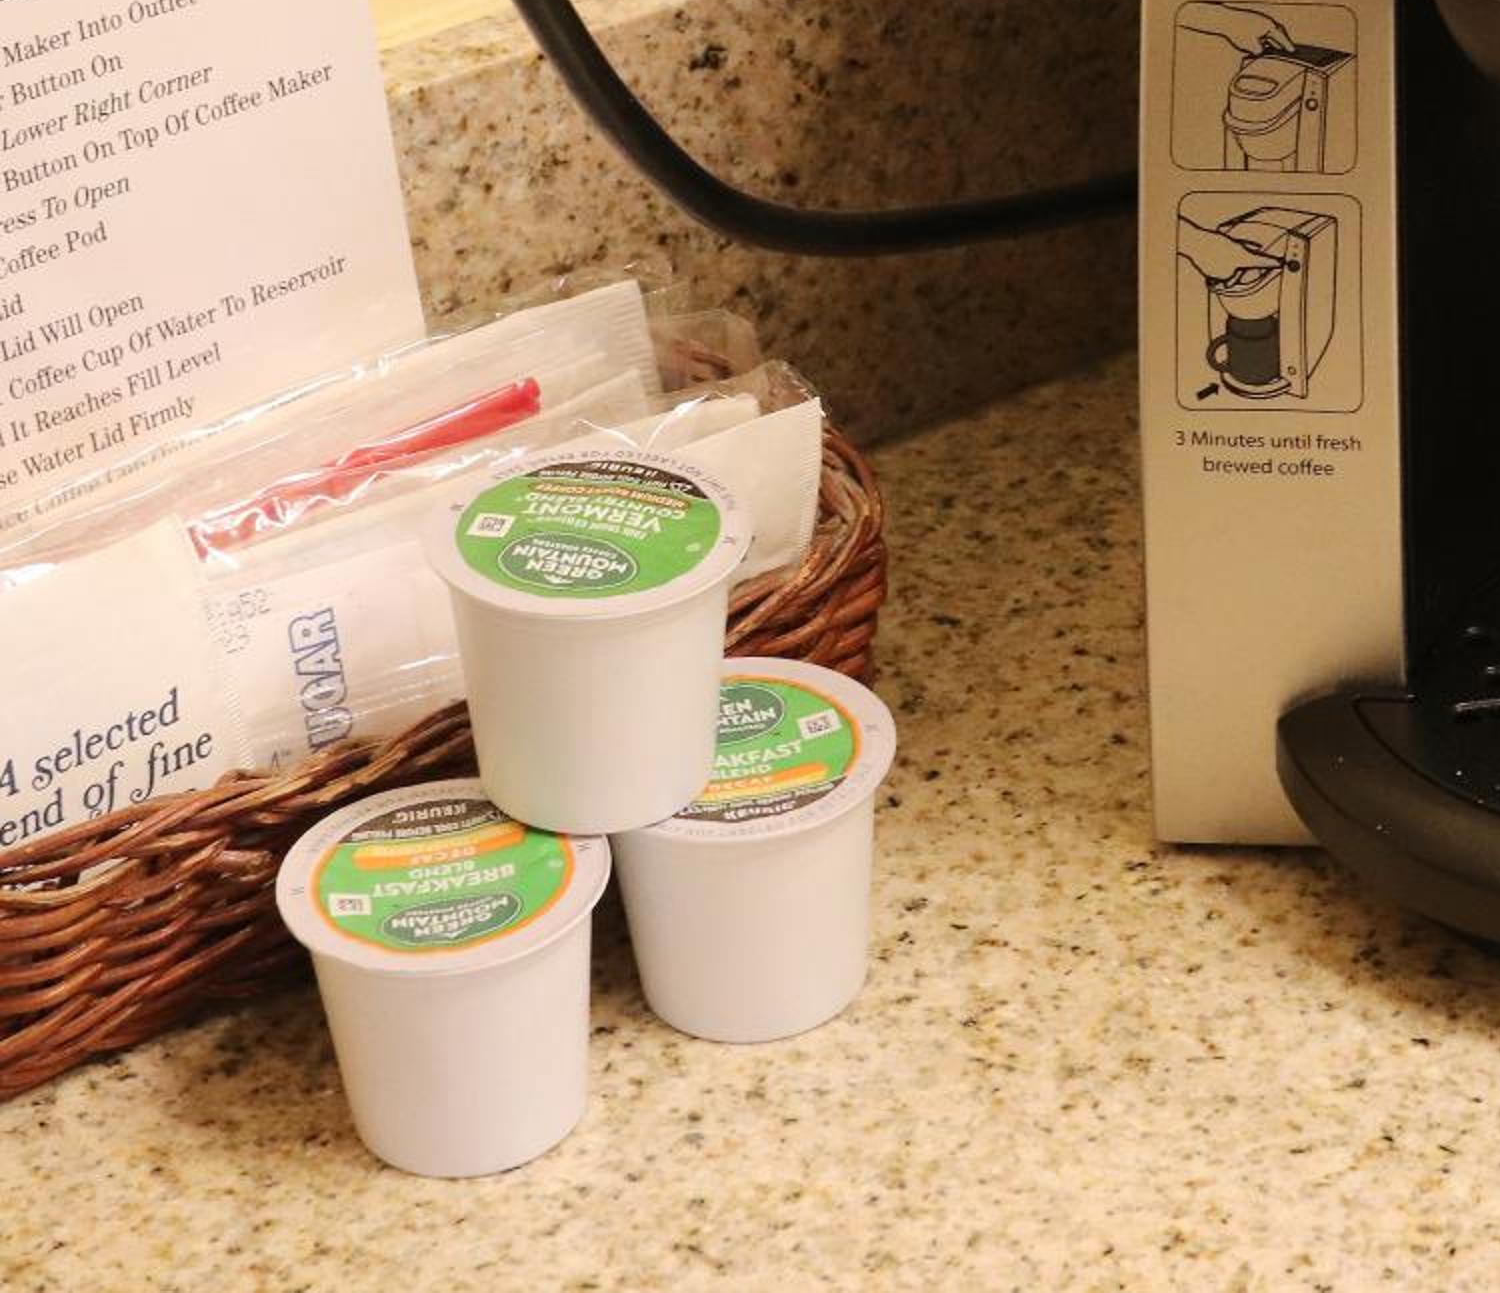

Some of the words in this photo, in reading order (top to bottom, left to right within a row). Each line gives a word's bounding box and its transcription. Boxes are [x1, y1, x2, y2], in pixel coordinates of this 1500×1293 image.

[2, 27, 72, 67] Maker
[77, 12, 123, 41] Into
[11, 67, 85, 106] Button
[91, 53, 123, 78] On
[1, 113, 69, 151] Lower
[74, 88, 132, 127] Right
[138, 64, 214, 104] Corner
[3, 153, 77, 192] Button
[83, 138, 116, 164] On
[118, 123, 159, 152] Top
[165, 108, 191, 135] Of
[195, 87, 262, 125] Coffee
[267, 62, 333, 102] Maker
[0, 208, 37, 235] ess
[41, 195, 67, 220] To
[74, 174, 131, 211] Open
[64, 221, 108, 255] Pod
[0, 330, 36, 363] Lid
[39, 316, 84, 349] Will
[88, 292, 144, 329] Open
[8, 362, 76, 401] Coffee
[82, 343, 124, 376] Cup
[128, 326, 154, 355] Of
[156, 308, 217, 342] Water
[220, 293, 246, 319] To
[250, 254, 347, 307] Reservoir
[10, 418, 30, 444] It
[34, 386, 123, 434] Reaches
[127, 365, 162, 397] Fill
[167, 341, 221, 381] Level
[22, 442, 85, 481] Water
[89, 422, 125, 455] Lid
[129, 392, 197, 435] Firmly
[1175, 430, 1186, 446] 3
[1191, 430, 1265, 449] Minutes
[1270, 434, 1312, 450] until
[1316, 435, 1362, 452] fresh
[1203, 457, 1273, 474] brewed
[1277, 459, 1336, 476] coffee
[521, 501, 663, 533] VERMONT
[597, 495, 686, 520] COUNTRY
[511, 545, 628, 573] MOUNTAIN
[525, 558, 603, 580] GREEN
[288, 606, 354, 753] UGAR
[31, 686, 180, 792] selected
[716, 739, 801, 767] AKFAST
[83, 760, 125, 819] of
[129, 731, 213, 804] fine
[394, 803, 467, 823] KEURIG
[372, 863, 516, 898] BREAKFAST
[407, 860, 476, 879] BLEND
